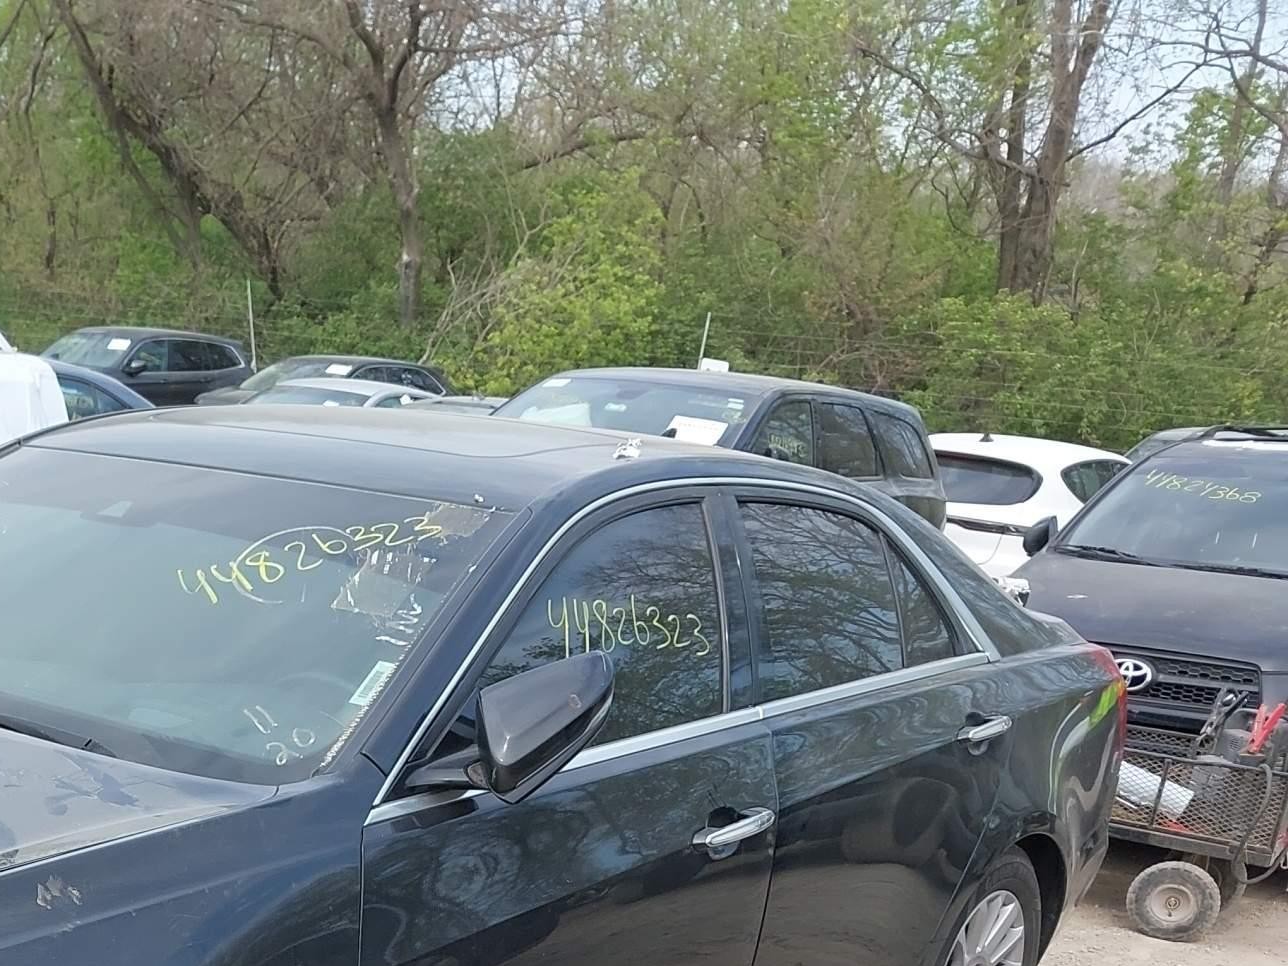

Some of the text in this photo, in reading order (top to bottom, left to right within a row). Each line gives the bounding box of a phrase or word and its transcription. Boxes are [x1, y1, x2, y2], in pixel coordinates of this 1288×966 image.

[1144, 468, 1262, 503] 44824368
[177, 516, 442, 604] 44826323
[548, 594, 710, 658] 44826323
